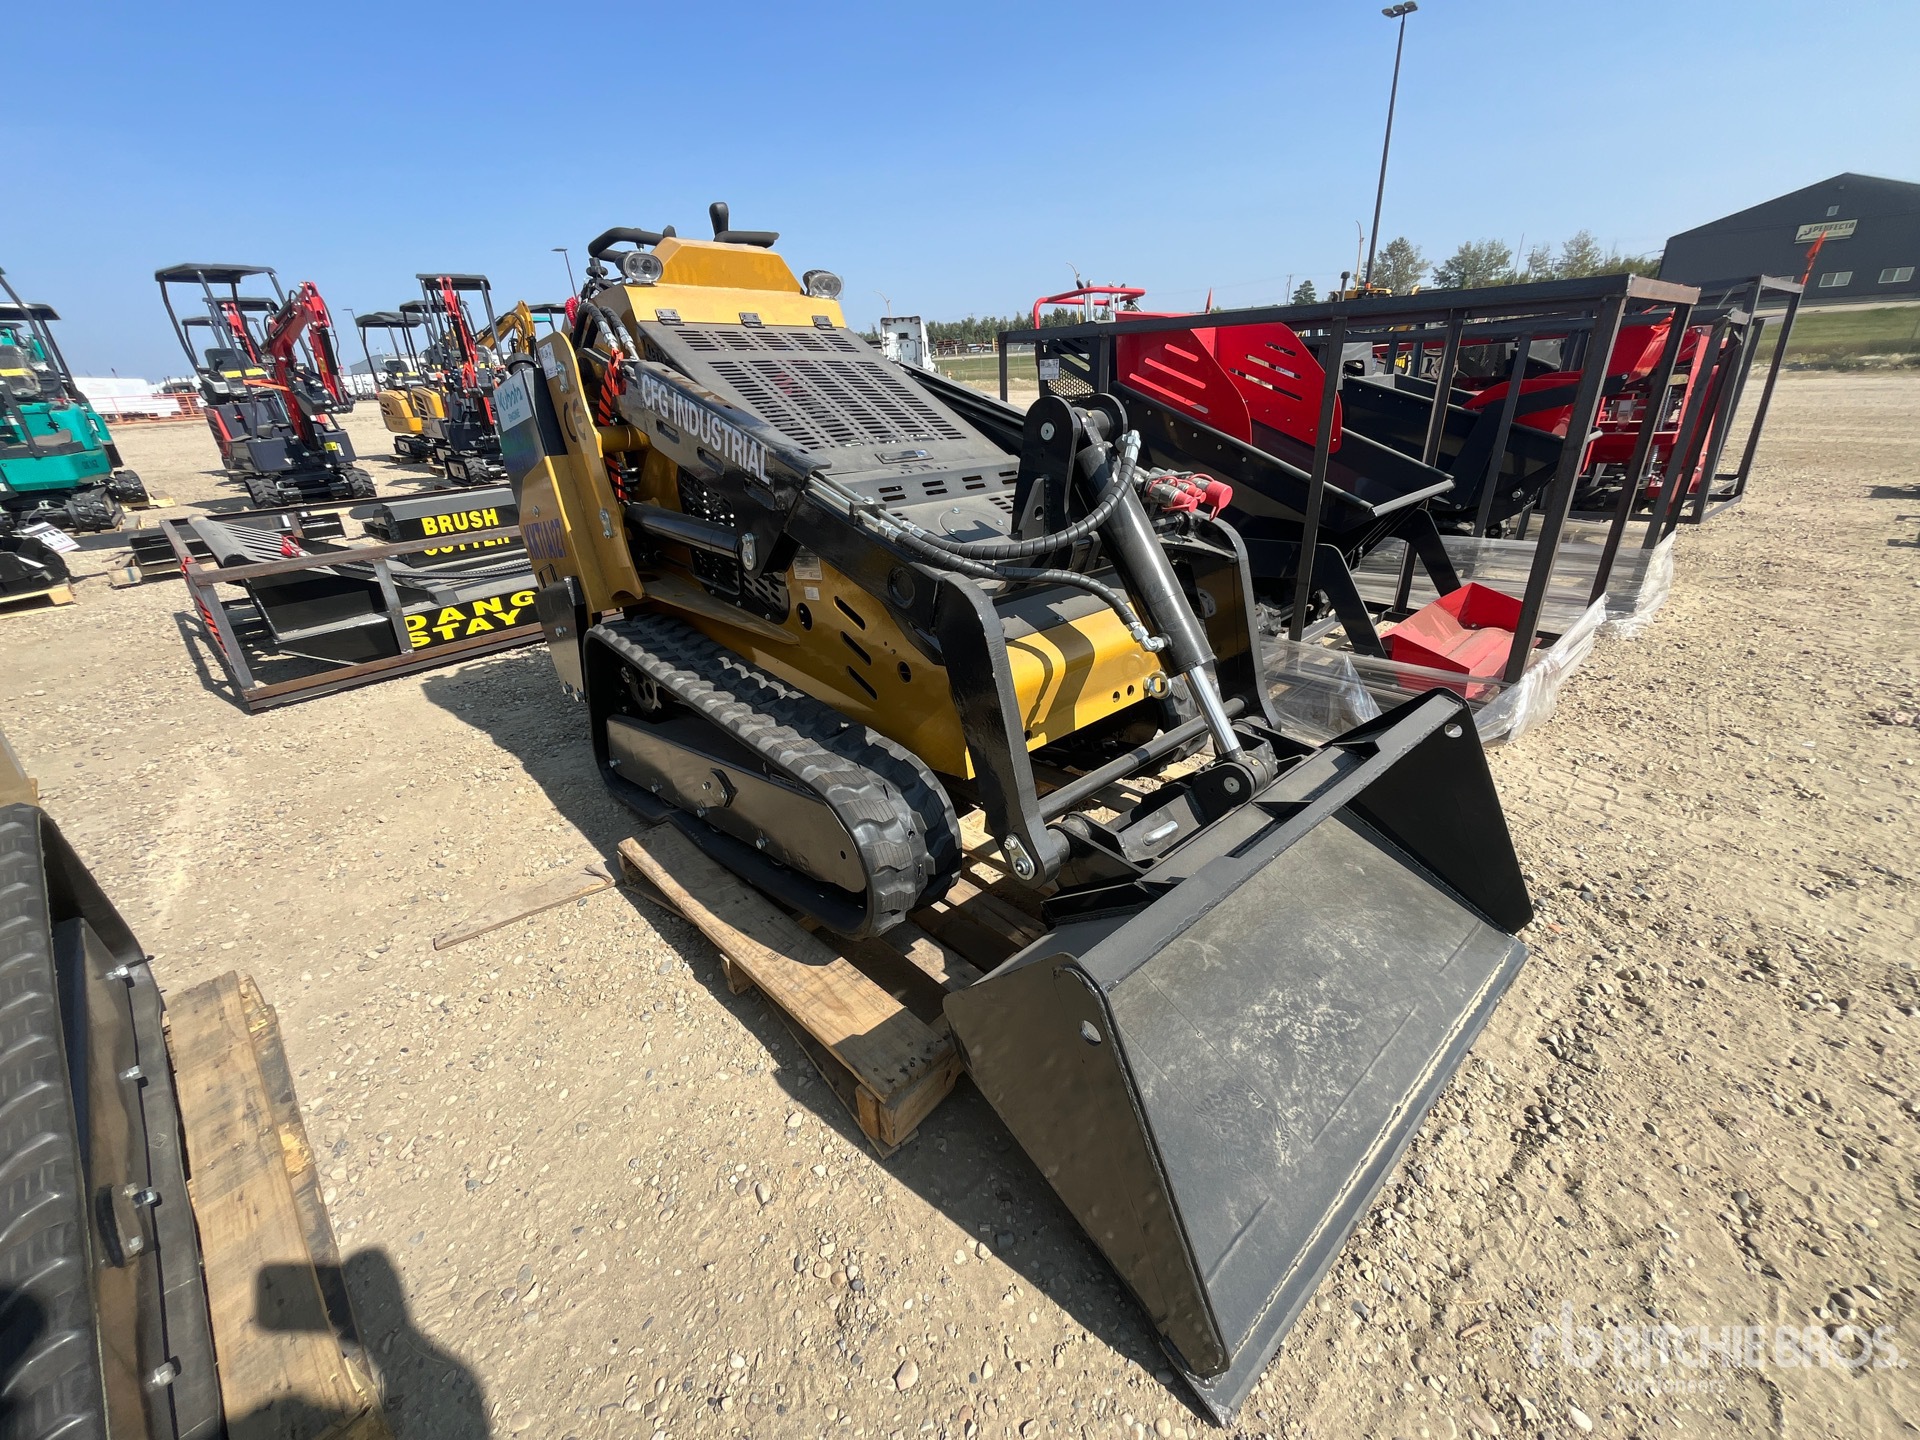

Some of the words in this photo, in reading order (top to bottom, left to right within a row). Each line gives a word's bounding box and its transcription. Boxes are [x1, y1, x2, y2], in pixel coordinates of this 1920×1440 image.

[641, 374, 669, 419] CFG
[673, 391, 770, 486] INDUSTRIAL
[421, 508, 499, 536] BRUSH
[408, 608, 521, 648] STAY
